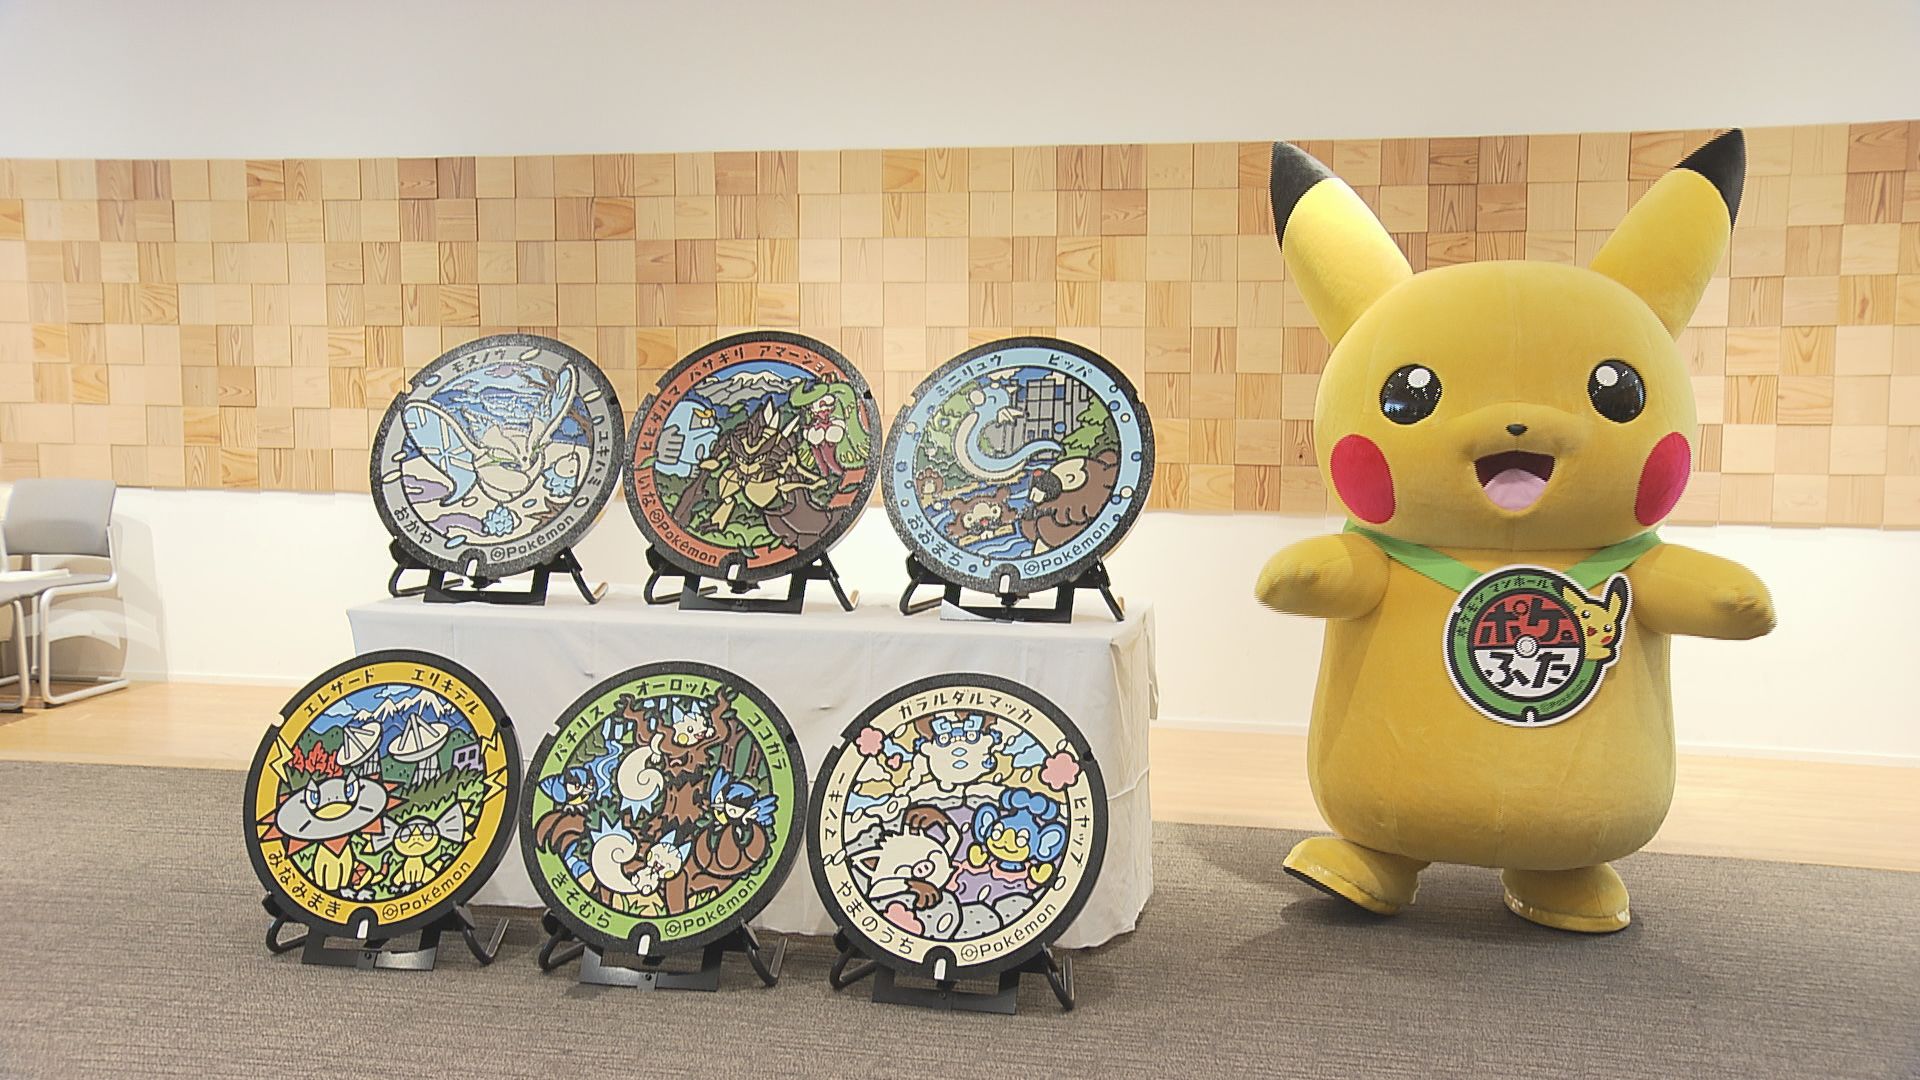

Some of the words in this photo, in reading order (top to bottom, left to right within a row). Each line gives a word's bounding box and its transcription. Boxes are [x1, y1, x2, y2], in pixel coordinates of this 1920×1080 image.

[640, 385, 680, 451] ヒヒダルマ
[690, 347, 744, 382] バサギリ
[760, 345, 825, 372] アマージョ
[936, 354, 1002, 396] ミニリュウ
[1048, 353, 1093, 378] ビッパ
[452, 349, 506, 373] モスノウ
[588, 431, 610, 486] ユキハミ
[638, 475, 656, 508] いな
[394, 506, 432, 544] おかや
[506, 515, 574, 558] Pokémon
[658, 521, 718, 565] Pokémon
[907, 514, 963, 567] おおまち
[1041, 521, 1110, 571] Pokémon
[304, 667, 375, 717] エレザード
[411, 669, 480, 715] エリキテル
[1484, 651, 1571, 688] ふた
[555, 705, 604, 761] パチリス
[636, 679, 711, 696] オーロット
[748, 712, 787, 770] ココガラ
[825, 772, 845, 840] マンキー
[899, 689, 1033, 723] ガラルダルマッカ
[1070, 797, 1090, 868] ヒヤップ
[268, 850, 341, 917] みなみまき
[400, 861, 471, 915] Pokémon
[551, 871, 612, 929] きそむら
[683, 879, 757, 931] Pokémon
[836, 880, 914, 955] やまのうち
[980, 902, 1056, 956] Pokémon
